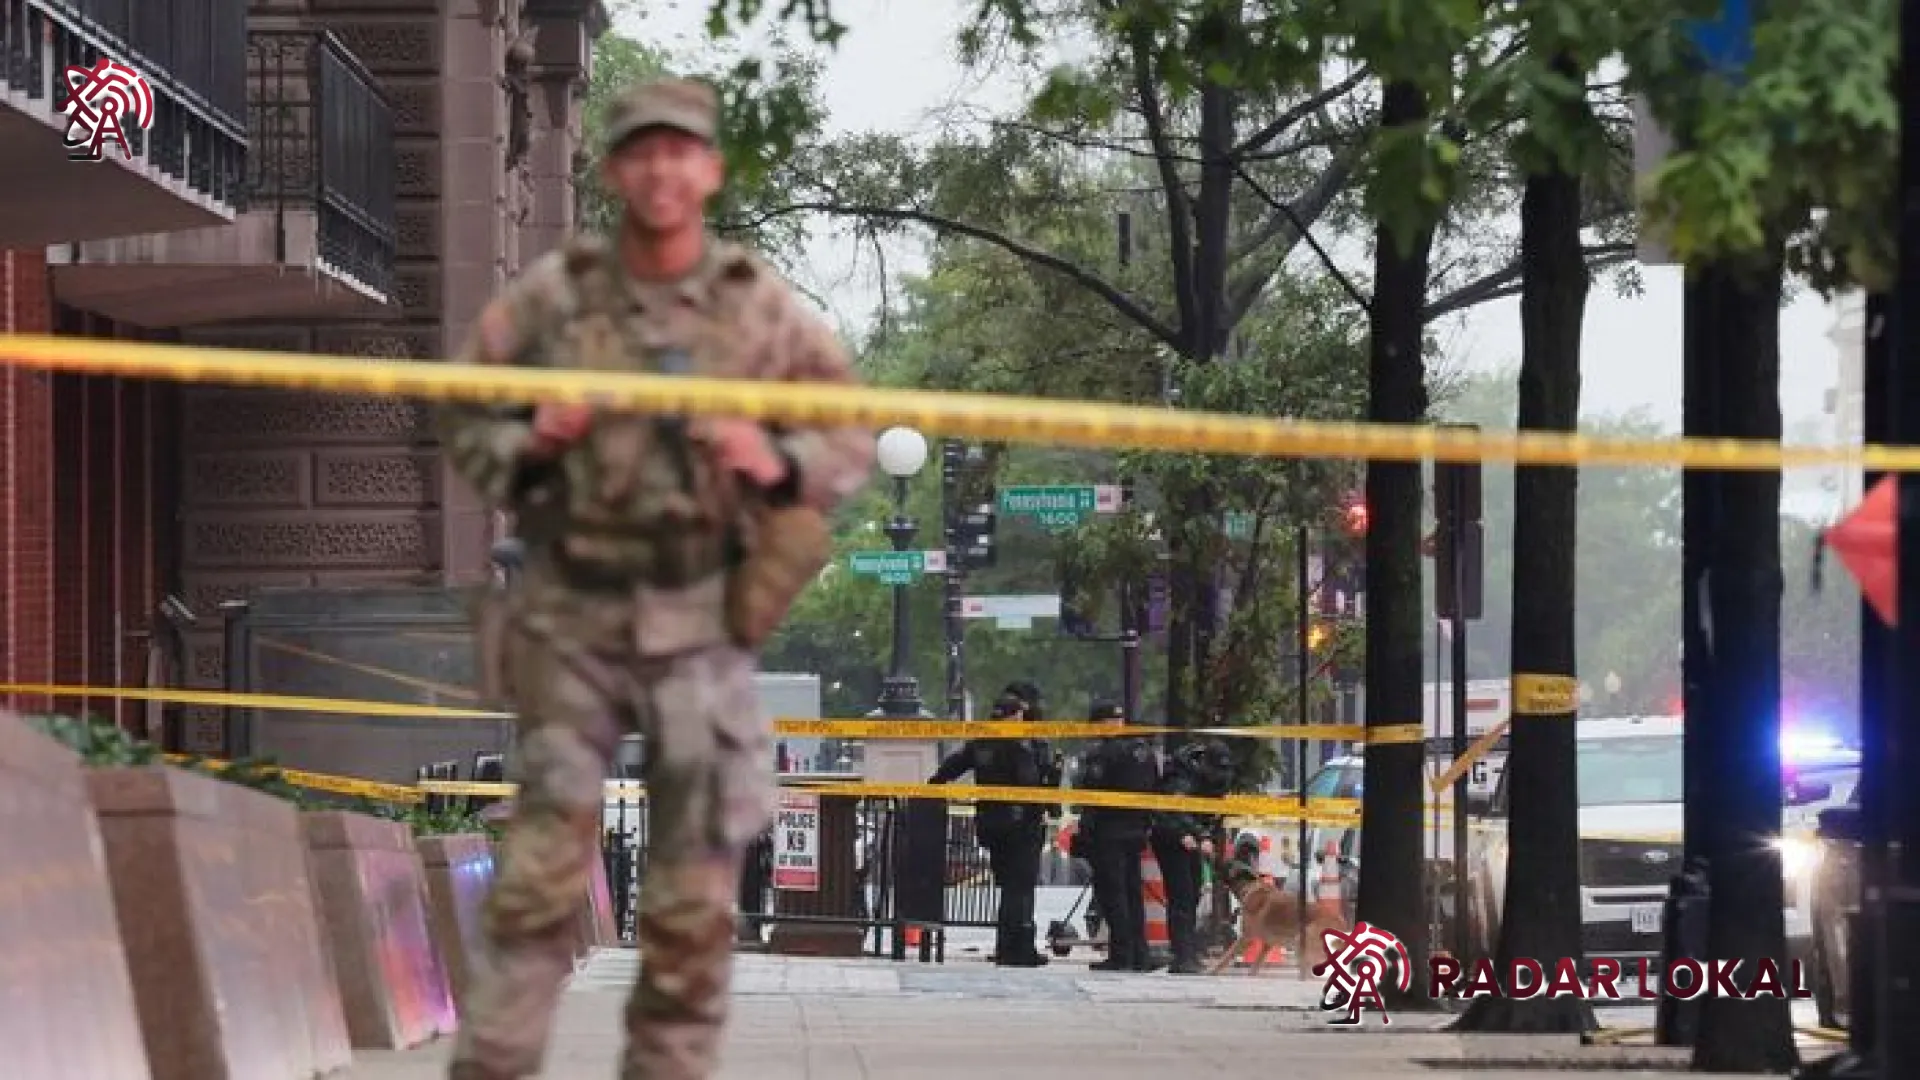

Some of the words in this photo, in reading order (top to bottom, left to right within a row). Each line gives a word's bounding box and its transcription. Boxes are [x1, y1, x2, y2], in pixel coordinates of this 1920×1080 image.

[1003, 488, 1076, 512] Pennsylvania
[778, 811, 816, 828] POLICE
[787, 830, 805, 852] K9
